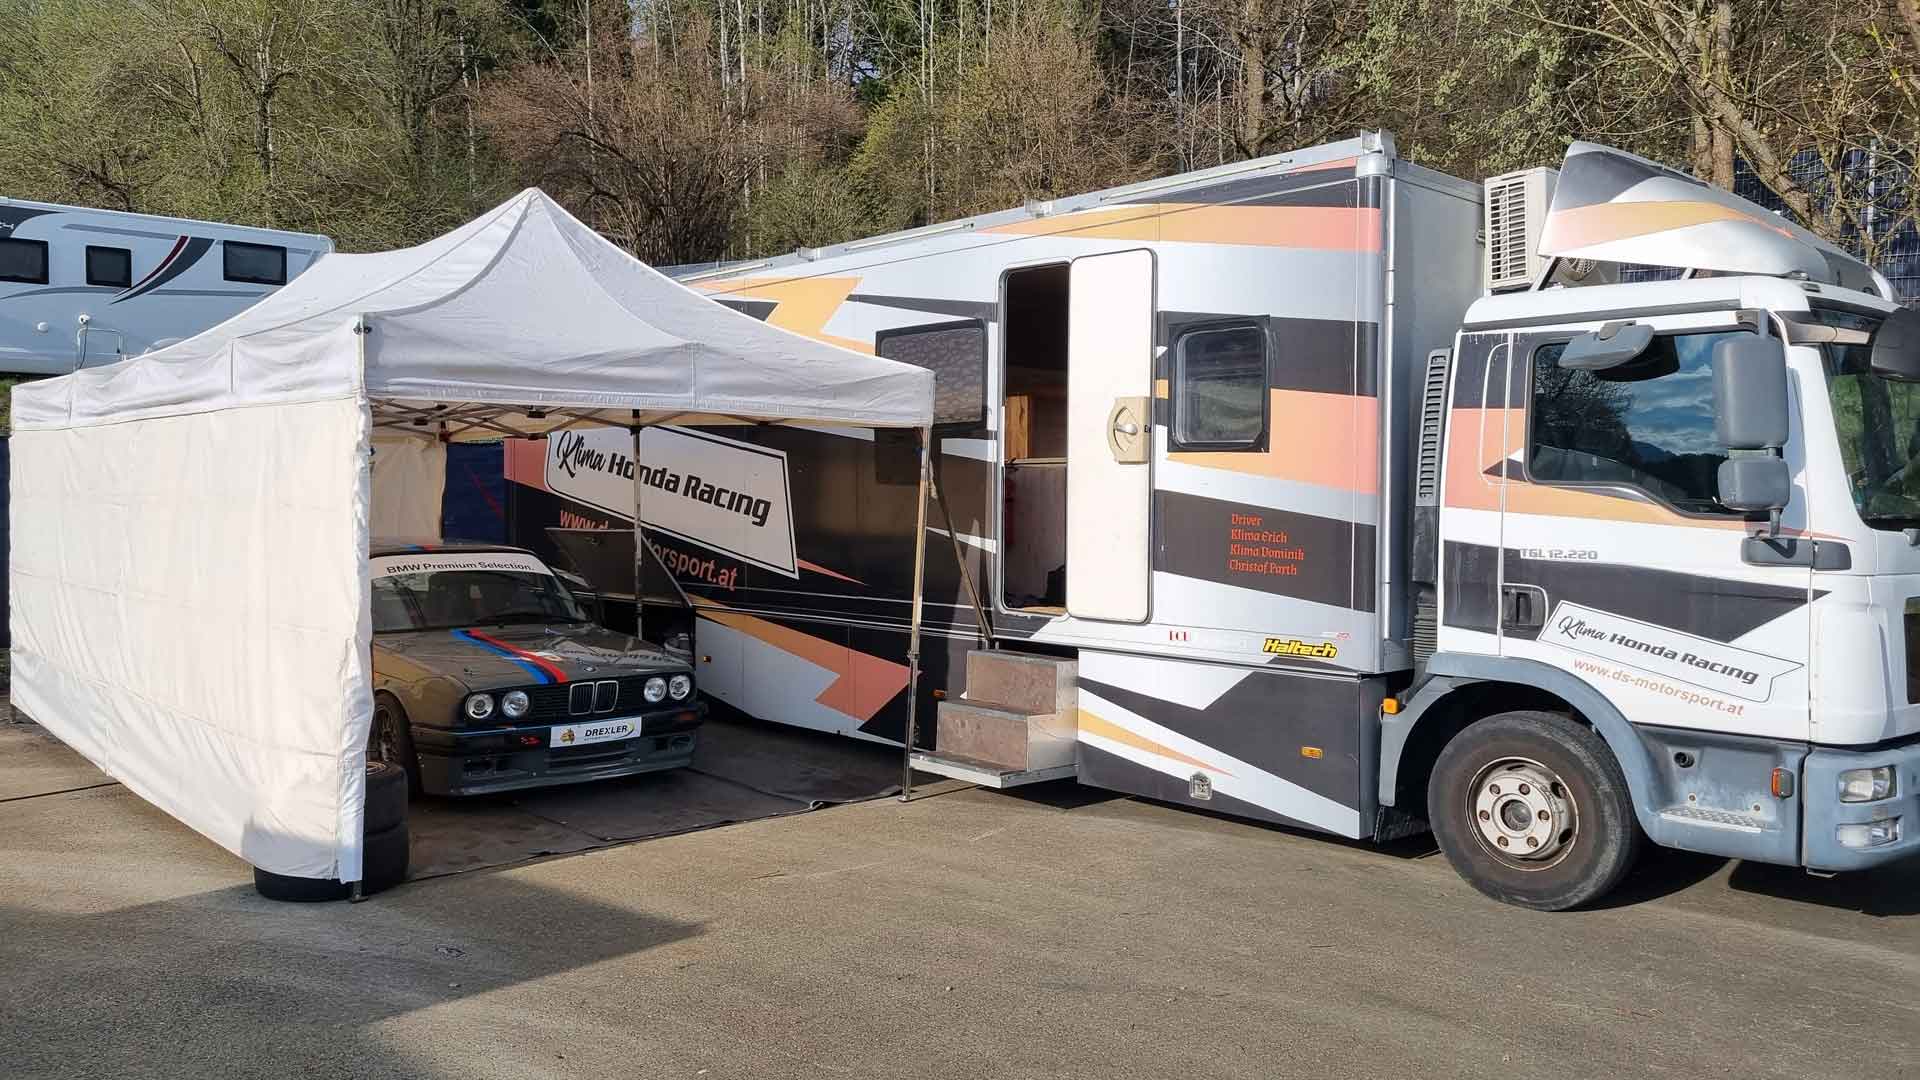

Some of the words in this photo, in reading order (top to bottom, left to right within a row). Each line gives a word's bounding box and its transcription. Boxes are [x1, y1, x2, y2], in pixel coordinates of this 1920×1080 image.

[557, 430, 606, 478] Klima
[607, 452, 681, 494] Honda
[682, 474, 772, 528] Racing
[1231, 513, 1263, 526] Driver
[1231, 528, 1260, 541] Klima
[1262, 530, 1288, 544] Erich
[1231, 543, 1259, 557] Klima
[1261, 546, 1304, 560] Dominik
[1520, 548, 1545, 558] TGL
[1548, 549, 1599, 560] 12.220
[386, 564, 421, 574] BMW
[423, 561, 478, 570] Premium
[479, 561, 536, 571] Selection.
[1263, 638, 1338, 658] Haltech
[1558, 616, 1607, 640] Klima
[1608, 633, 1678, 661] Honda
[1679, 652, 1760, 685] Racing
[1574, 658, 1745, 716] www.ds-motorsport.at
[584, 725, 628, 737] DREXLER
